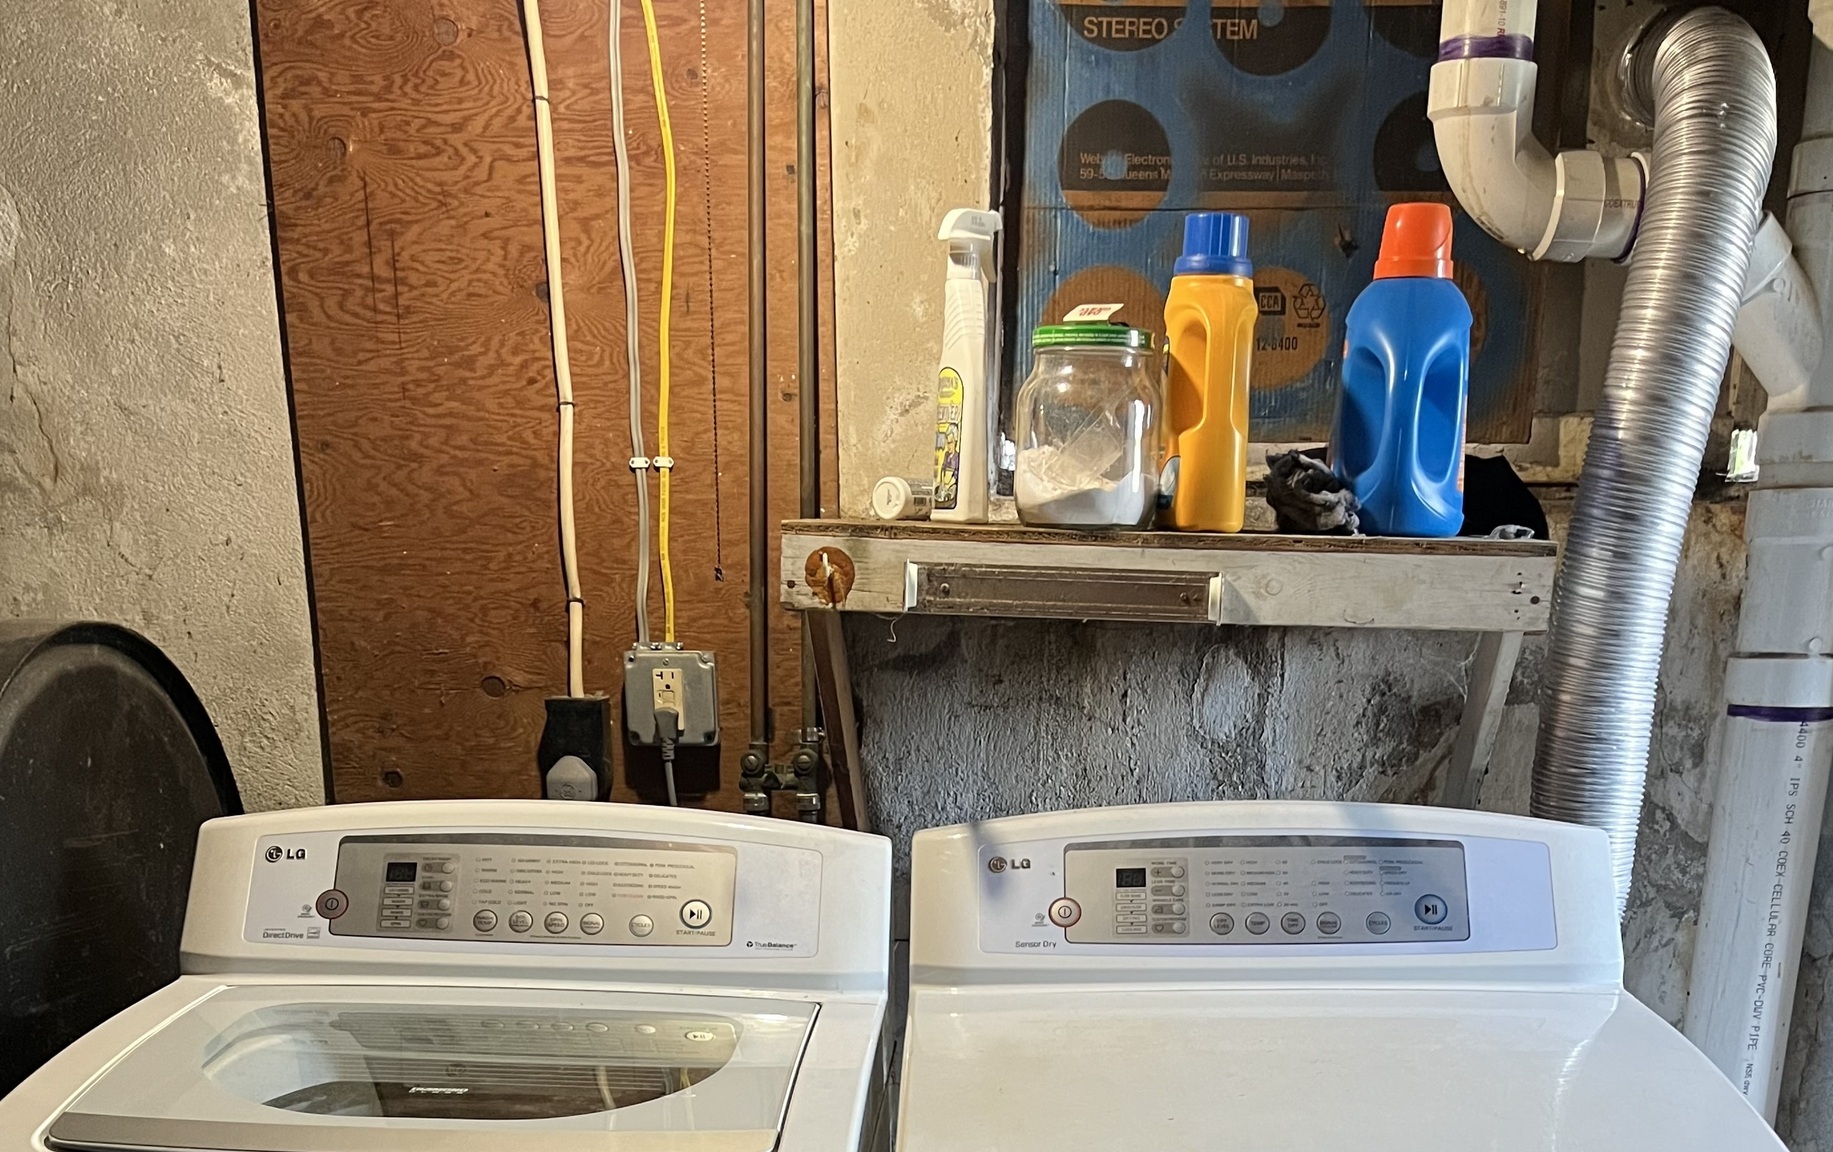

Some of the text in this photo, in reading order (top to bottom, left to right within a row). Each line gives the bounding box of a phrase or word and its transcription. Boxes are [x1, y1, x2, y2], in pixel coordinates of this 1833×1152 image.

[1083, 16, 1168, 39] STEREO
[1124, 153, 1170, 166] Electron
[1209, 168, 1275, 181] Expressway
[1260, 294, 1280, 309] CCA
[1788, 777, 1801, 797] IPS
[1784, 804, 1797, 824] SCH
[1780, 830, 1791, 844] 40
[286, 848, 306, 860] LG
[1011, 858, 1031, 870] LG
[1015, 940, 1057, 949] Sensor Dry
[1747, 1025, 1761, 1051] PIPE
